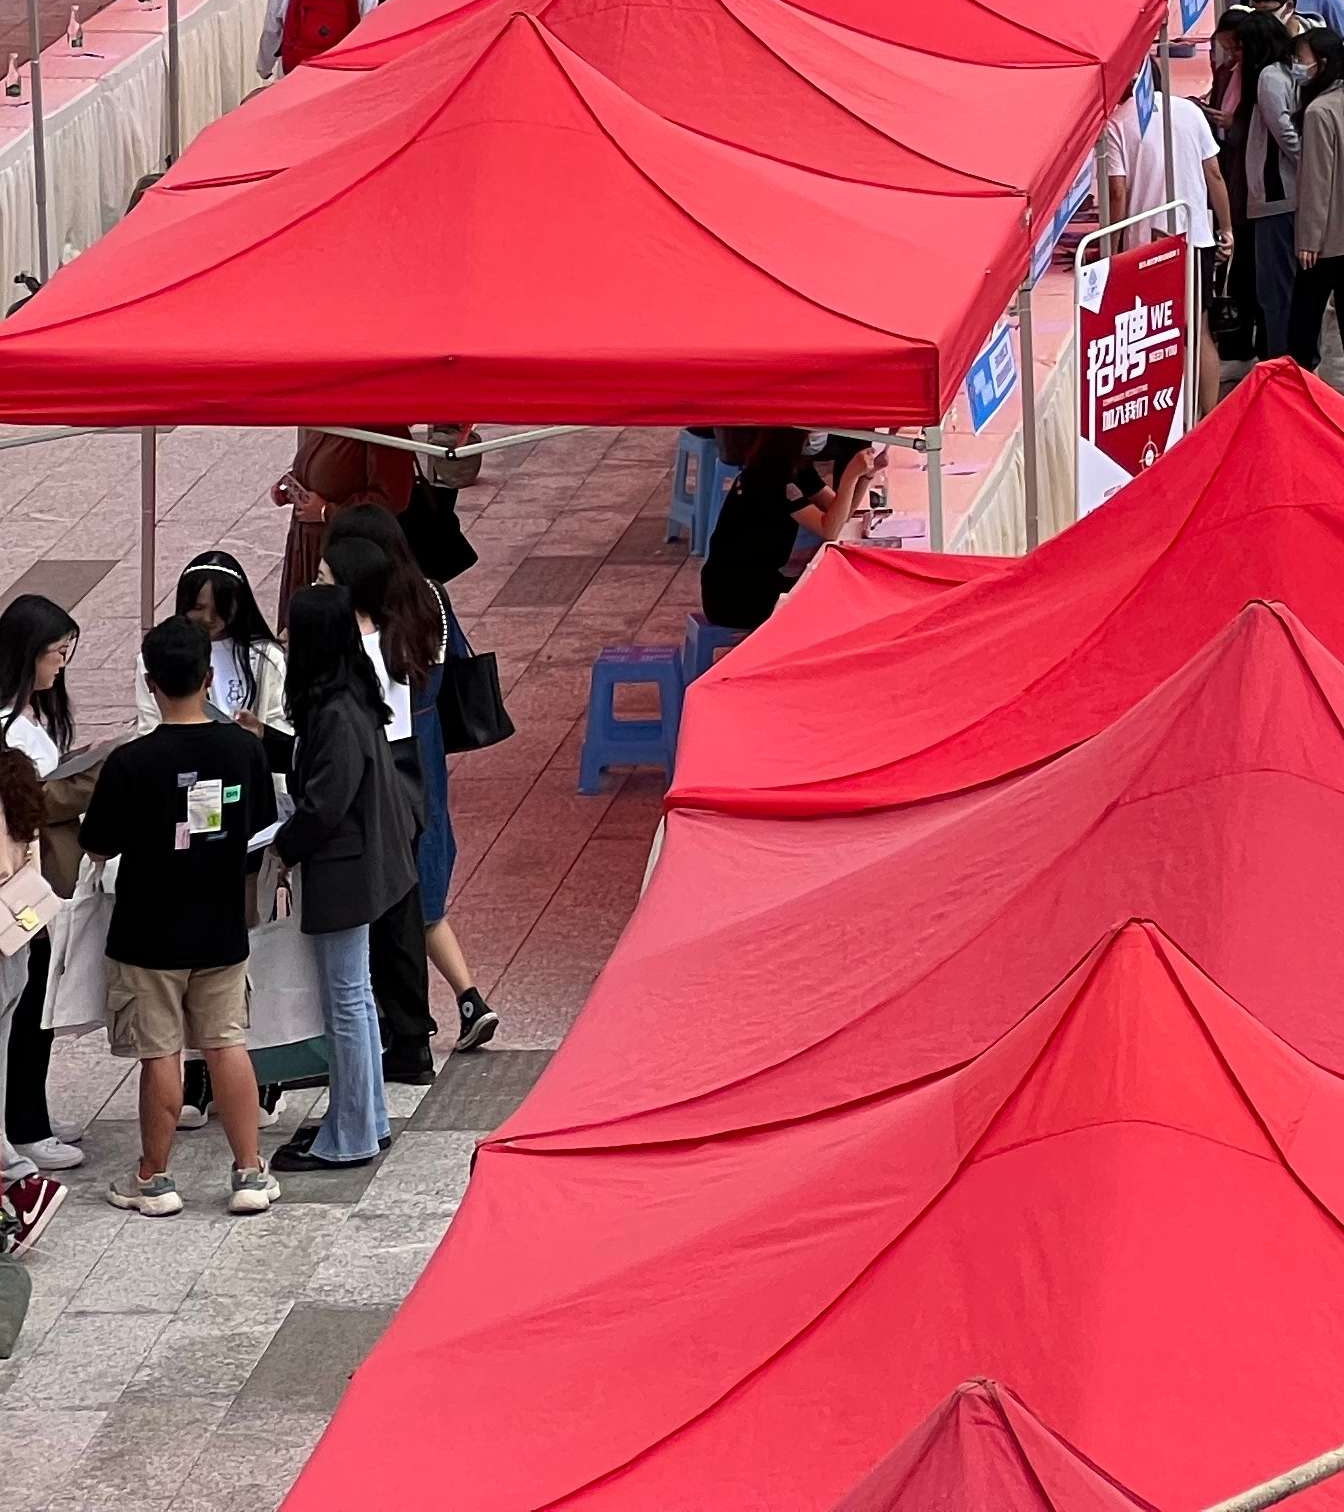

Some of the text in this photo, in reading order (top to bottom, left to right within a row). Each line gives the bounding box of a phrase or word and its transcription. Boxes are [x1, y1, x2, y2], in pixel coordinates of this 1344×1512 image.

[1150, 300, 1174, 331] WE
[1087, 296, 1149, 398] 招聘
[1102, 396, 1149, 432] 加入我们
